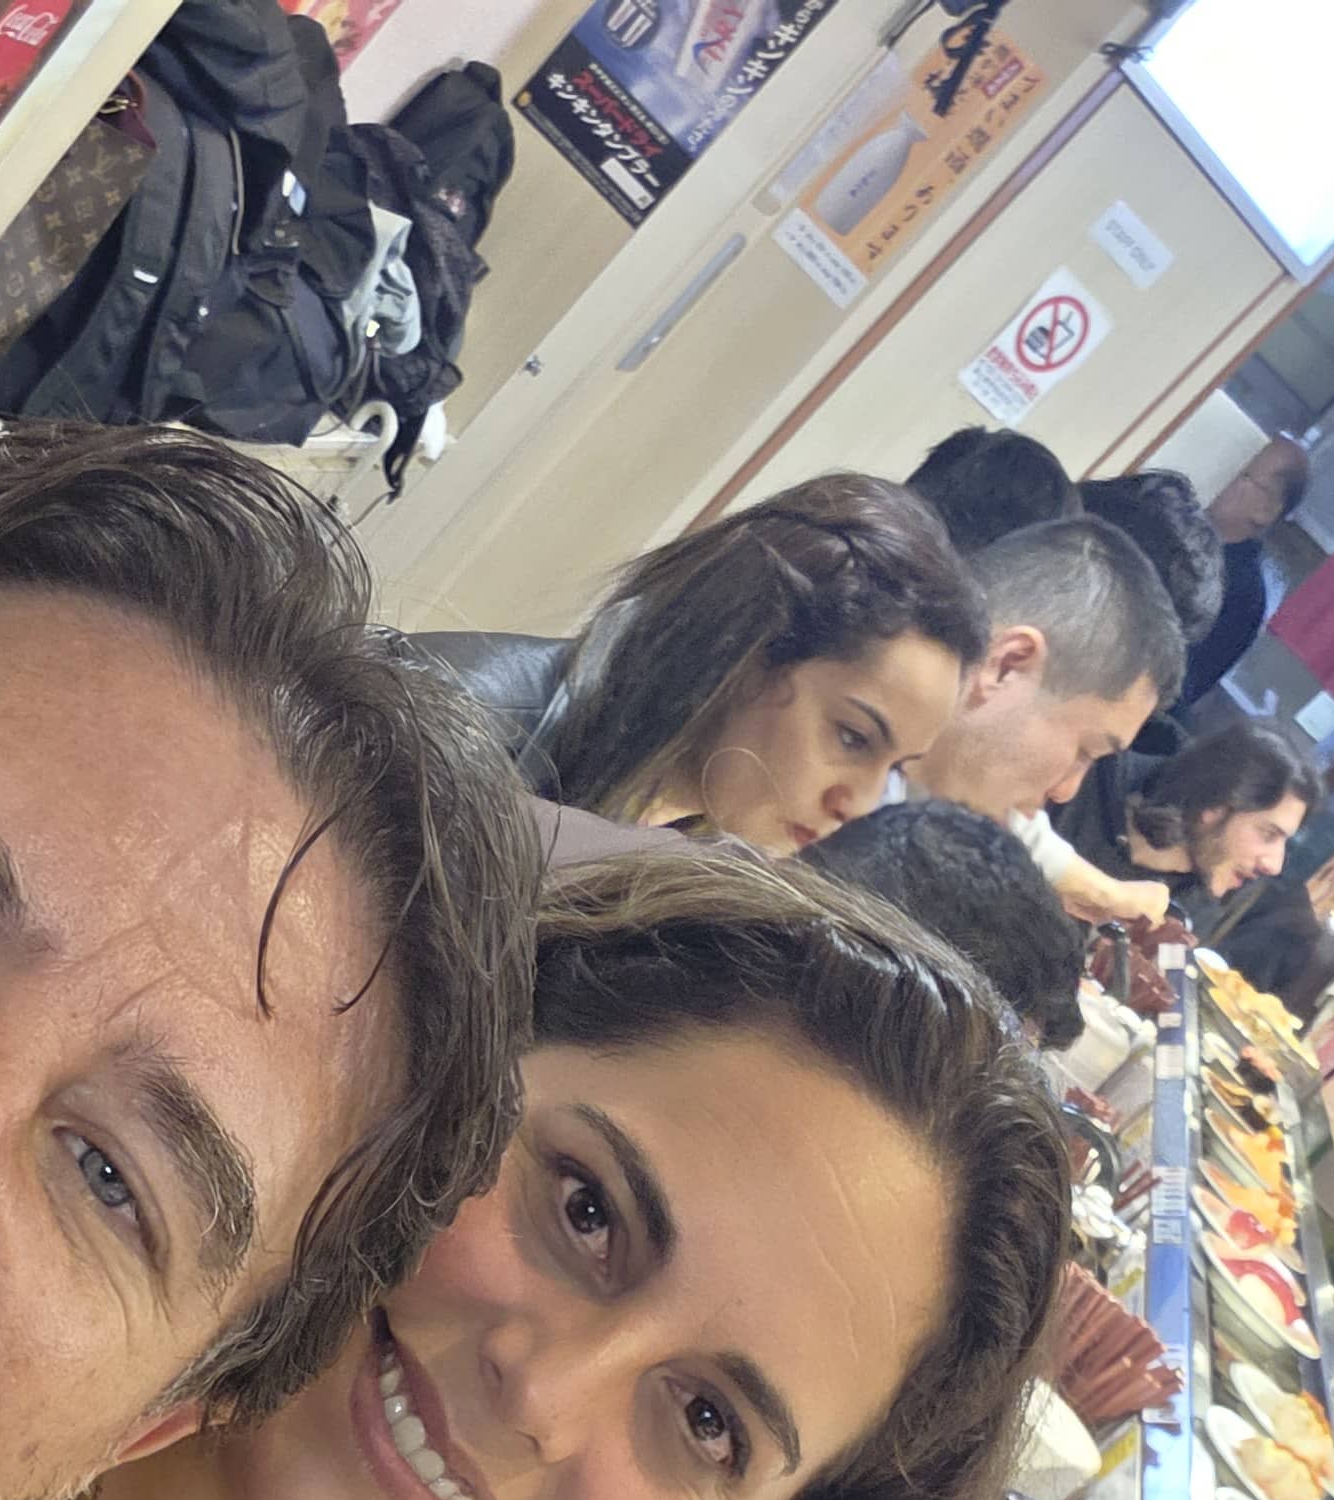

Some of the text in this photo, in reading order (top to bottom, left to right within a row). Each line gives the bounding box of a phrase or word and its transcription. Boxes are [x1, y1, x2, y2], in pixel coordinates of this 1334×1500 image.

[548, 72, 660, 187] キンキンタンブラー
